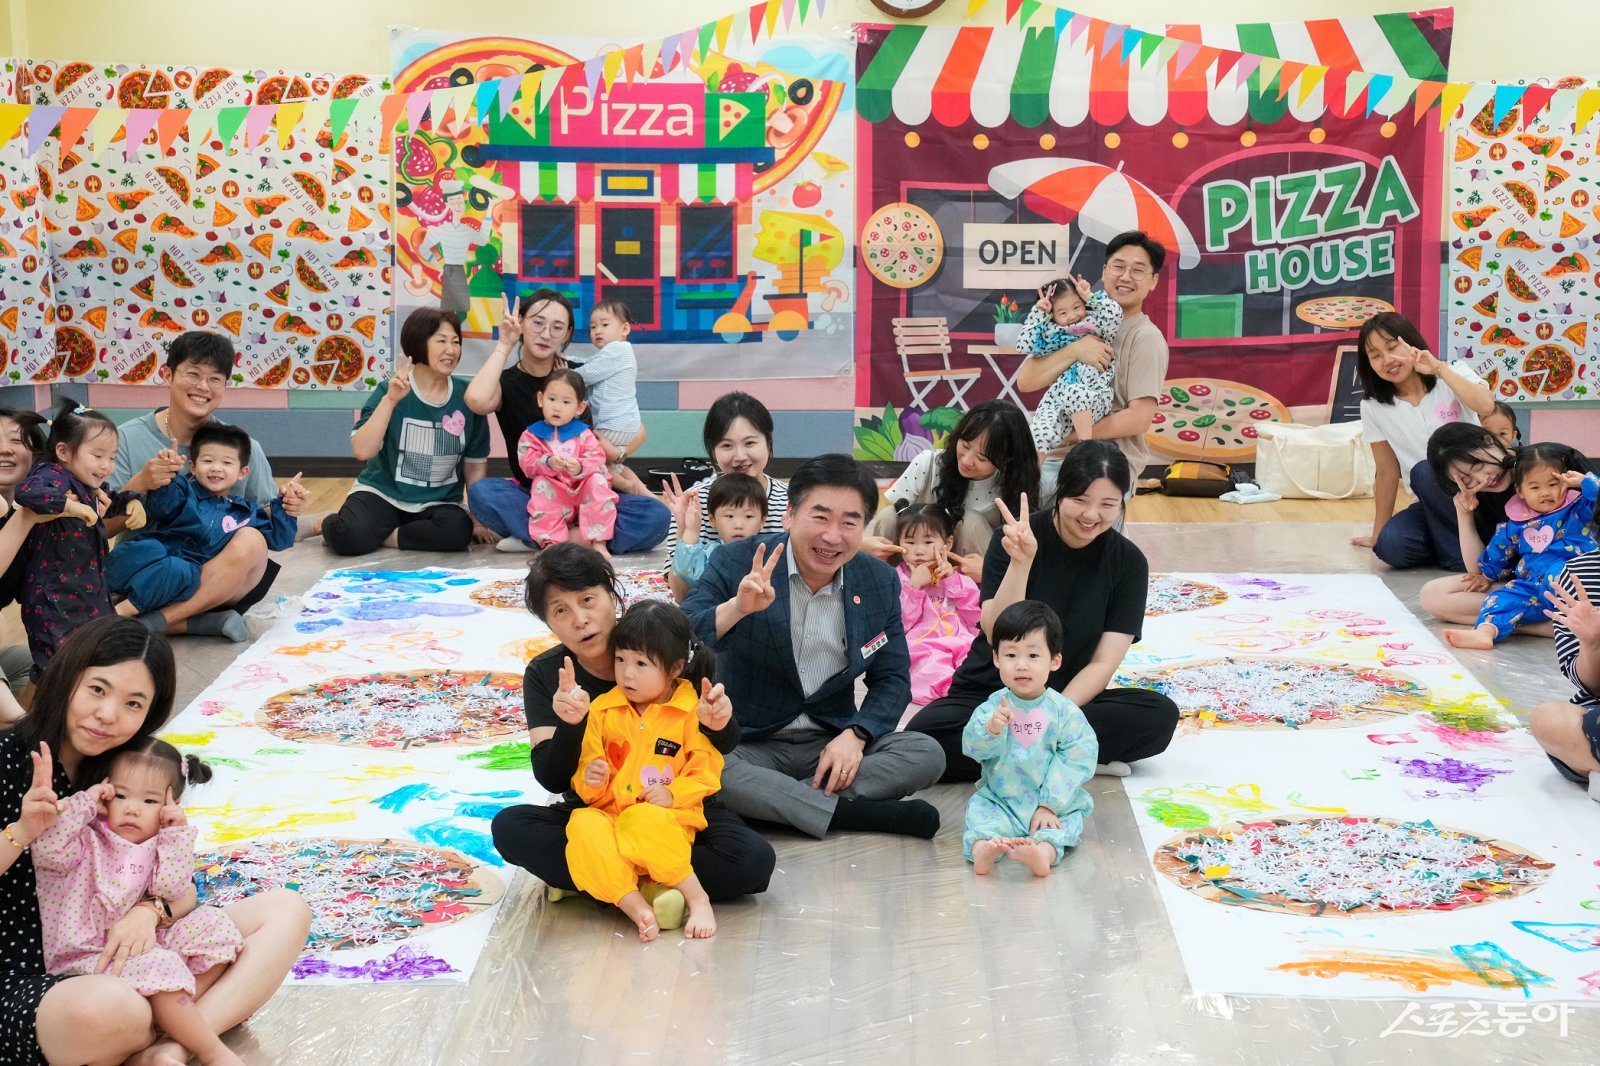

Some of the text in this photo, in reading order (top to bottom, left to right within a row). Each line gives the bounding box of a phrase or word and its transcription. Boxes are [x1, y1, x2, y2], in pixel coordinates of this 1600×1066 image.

[59, 74, 100, 106] HOT PIZZA
[226, 79, 238, 92] HOT
[560, 85, 694, 136] Pizza
[144, 171, 181, 212] HOT PIZZA
[282, 176, 317, 216] HOT PIZZA
[1203, 155, 1420, 252] PIZZA
[1492, 186, 1528, 225] HOT PIZZA
[170, 244, 206, 284] HOT PIZZA
[304, 250, 340, 288] HOT PIZZA
[979, 240, 1056, 264] OPEN
[1244, 231, 1395, 294] HOUSE
[1514, 259, 1551, 297] HOT PIZZA
[114, 340, 152, 374] HOT PIZZA
[248, 345, 287, 378] HOT PIZZA
[1474, 358, 1494, 376] IZZA
